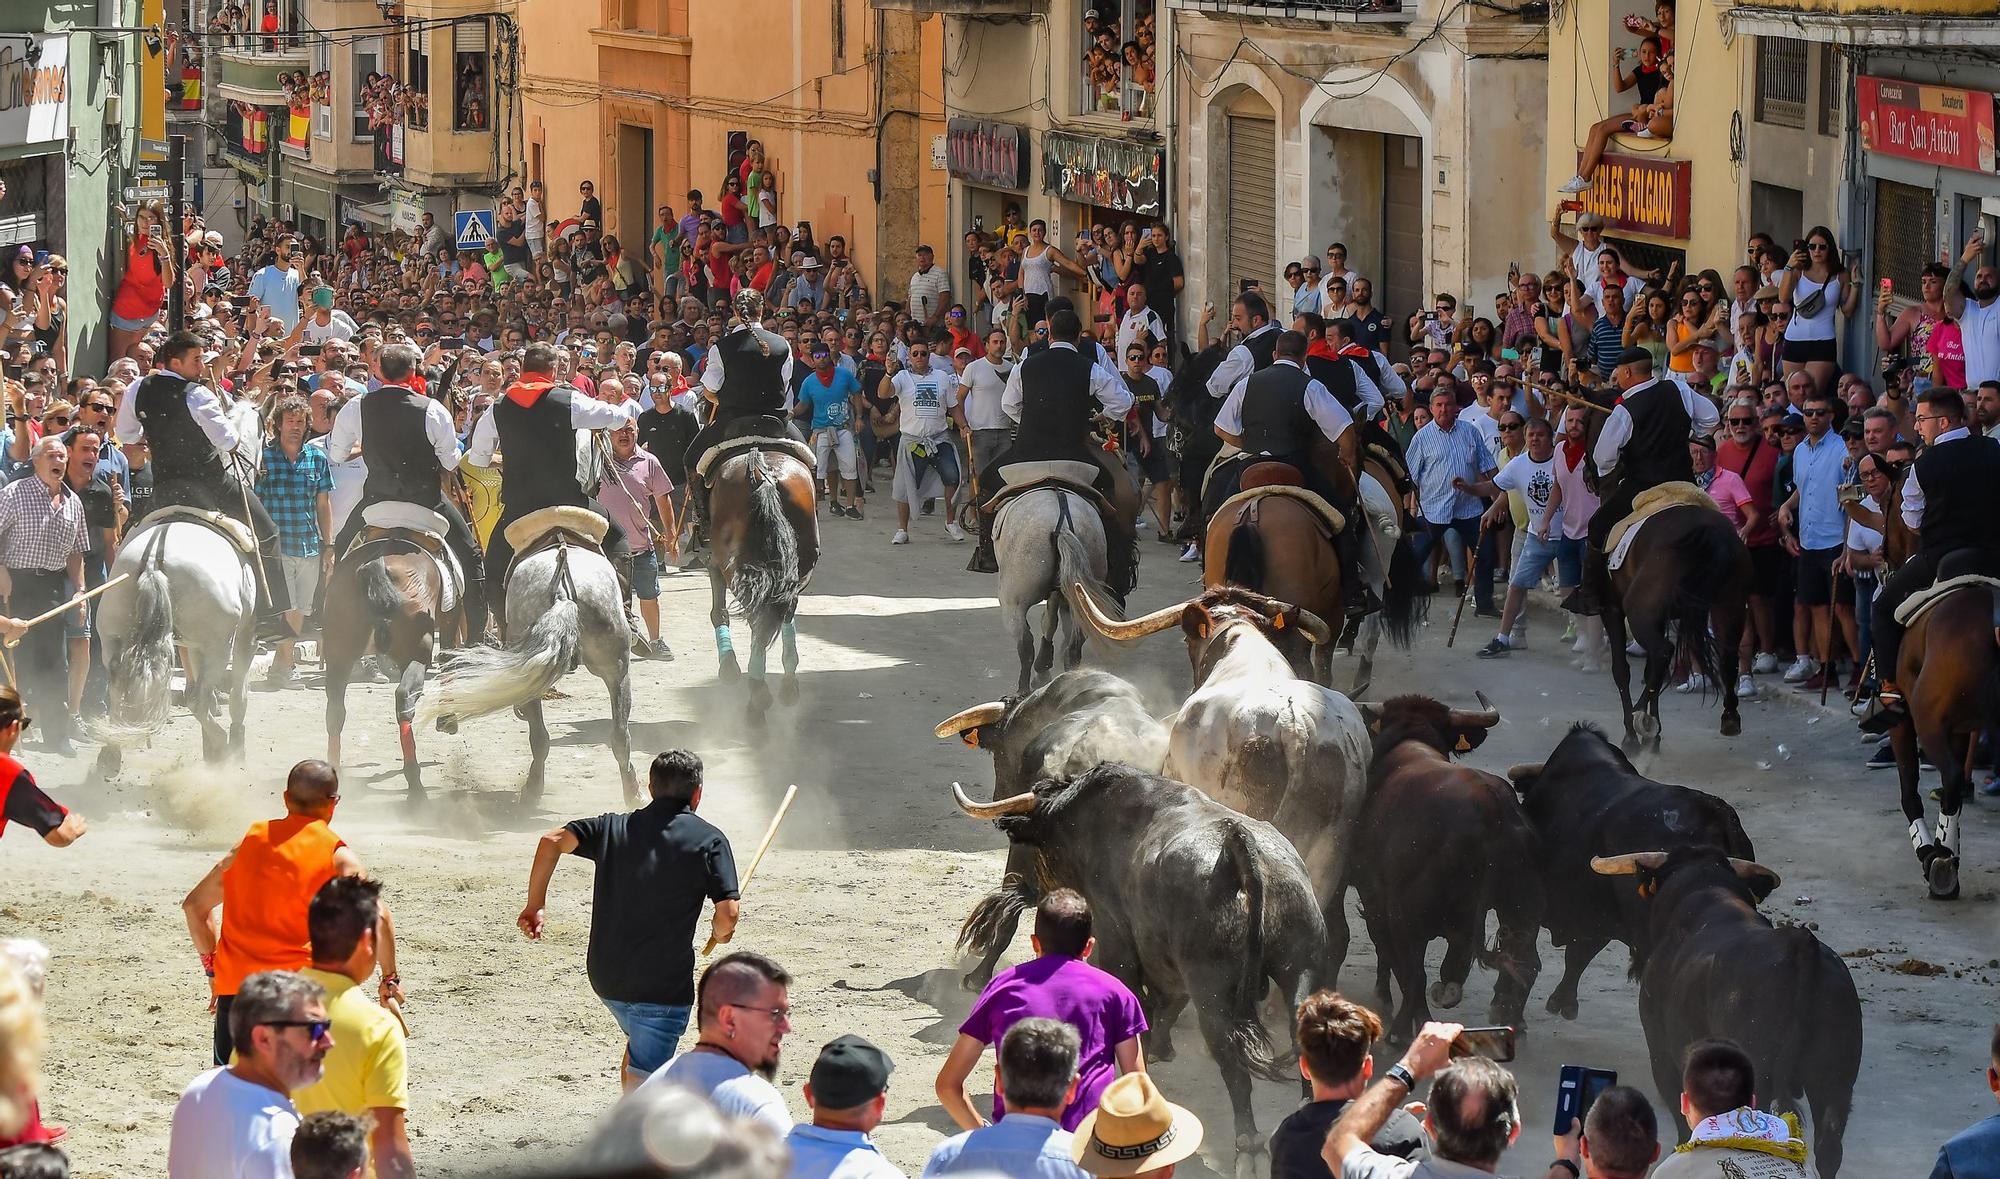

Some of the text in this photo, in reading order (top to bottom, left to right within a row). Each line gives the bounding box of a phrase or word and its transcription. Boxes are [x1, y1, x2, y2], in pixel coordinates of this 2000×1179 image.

[1889, 110, 1960, 156] Bar San Antón
[1628, 167, 1673, 227] FOLGADO
[1946, 340, 1959, 350] Bar
[913, 400, 941, 408] adidas
